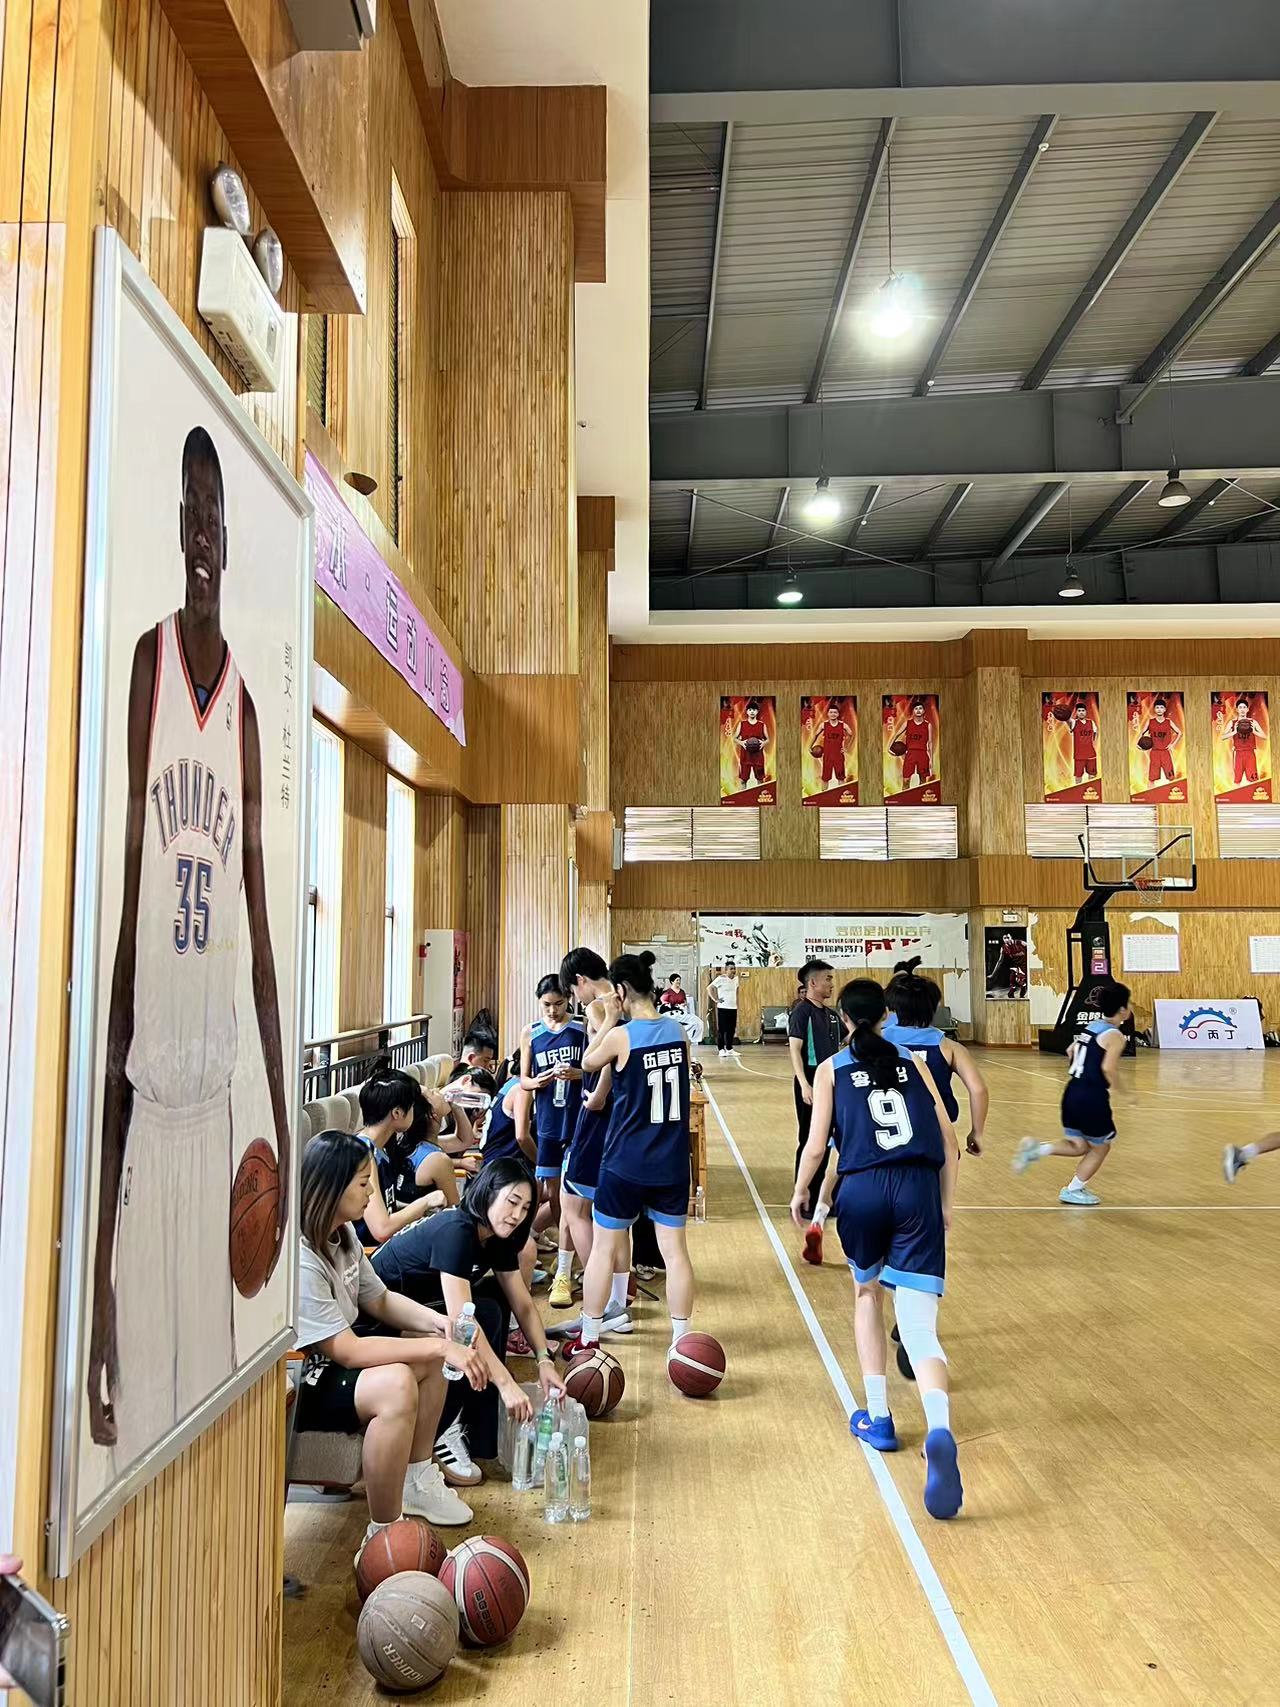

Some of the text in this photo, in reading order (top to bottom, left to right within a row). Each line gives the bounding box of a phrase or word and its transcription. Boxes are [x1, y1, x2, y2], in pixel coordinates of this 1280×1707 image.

[150, 757, 236, 872] THUNDER
[174, 853, 214, 954] 35
[1094, 962, 1104, 972] 2
[1076, 1011, 1105, 1022] 金陵
[1207, 1029, 1235, 1040] 丙丁
[647, 1065, 682, 1124] 11
[867, 1087, 914, 1151] 9
